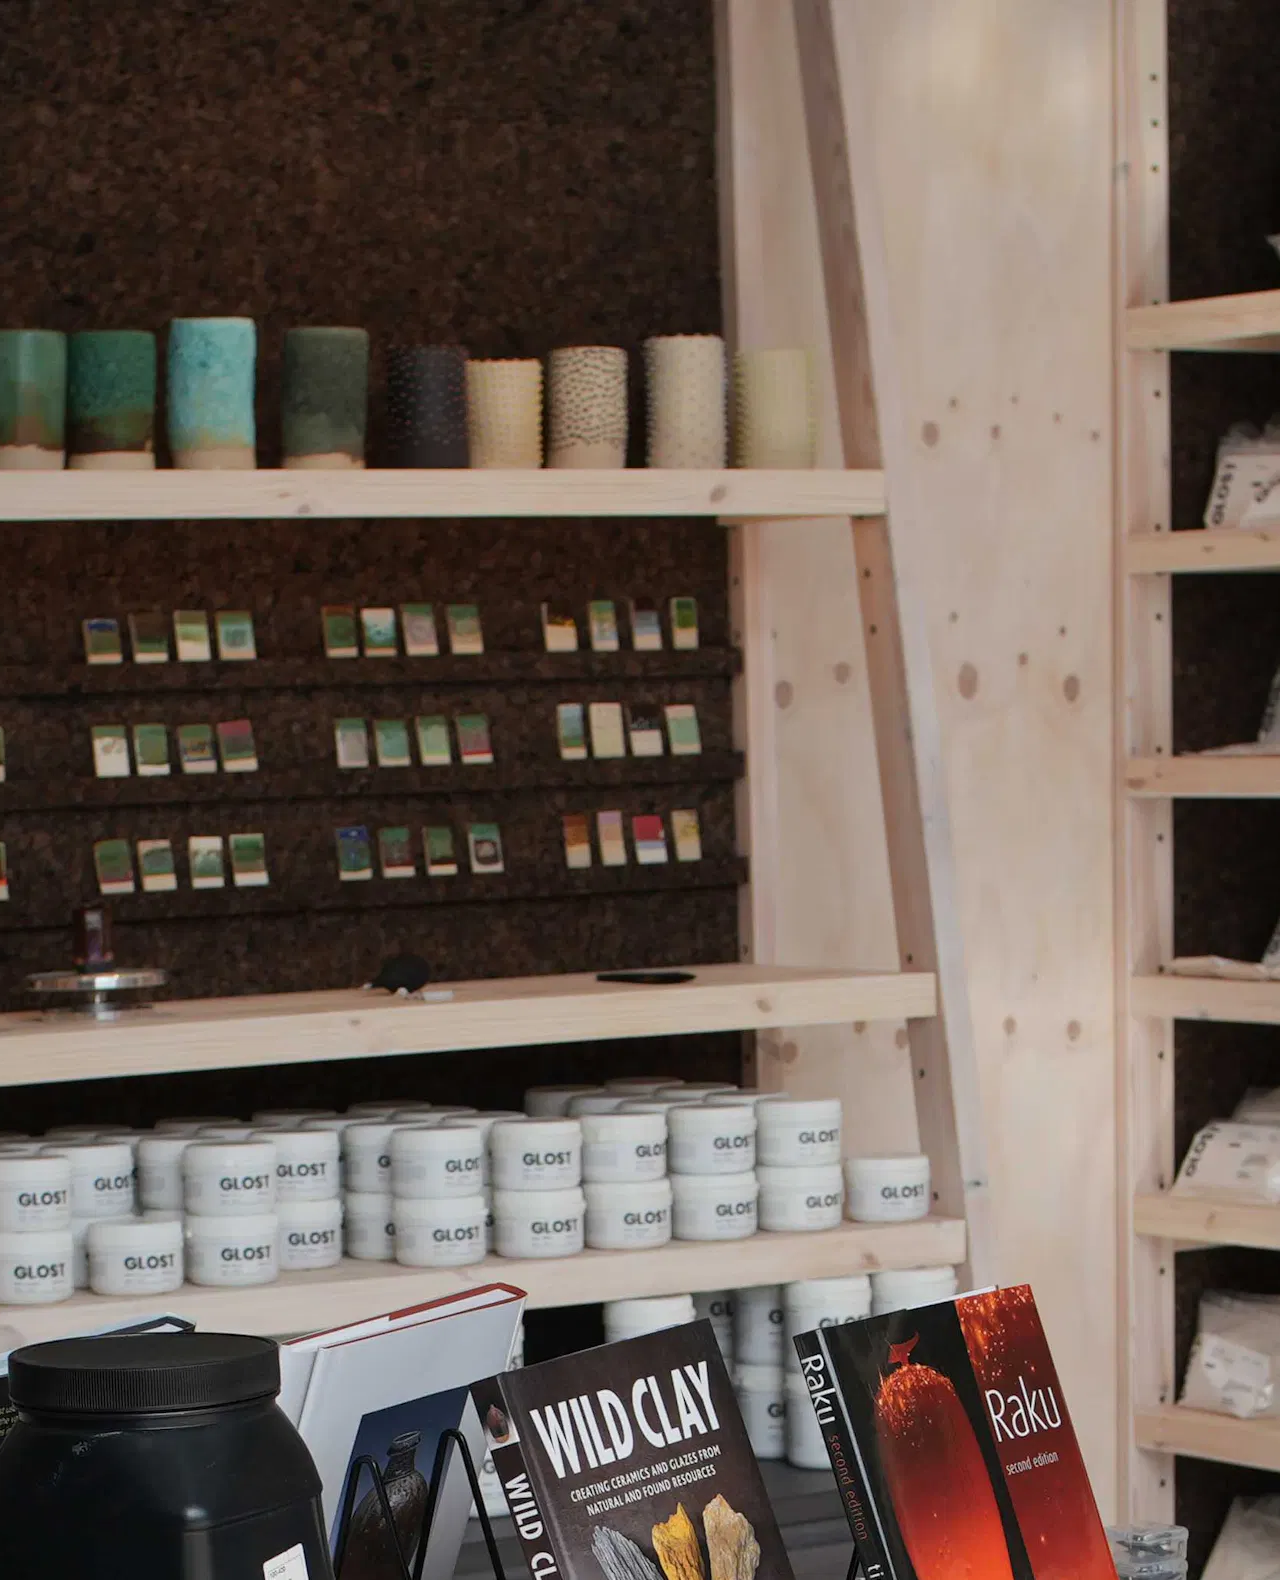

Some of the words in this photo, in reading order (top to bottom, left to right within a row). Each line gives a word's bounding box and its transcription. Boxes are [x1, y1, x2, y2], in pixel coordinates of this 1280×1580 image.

[1212, 462, 1237, 526] GLOST
[522, 1151, 572, 1167] GLOST
[276, 1162, 326, 1178] GLOST
[220, 1174, 270, 1191] GLOST
[18, 1190, 67, 1207] GLOST
[881, 1184, 925, 1200] GLOST
[433, 1226, 480, 1242] GLOST
[531, 1219, 578, 1234] GLOST
[288, 1229, 335, 1246] GLOST
[221, 1245, 271, 1262] GLOST
[124, 1254, 175, 1271] GLOST
[14, 1263, 65, 1280] GLOST
[984, 1375, 1062, 1442] Raku
[529, 1389, 634, 1479] WILD
[632, 1361, 720, 1448] CLAY
[801, 1354, 836, 1425] Raku
[828, 1434, 853, 1486] second
[844, 1489, 869, 1541] edition
[1005, 1456, 1032, 1476] second
[1032, 1451, 1059, 1468] edition
[570, 1480, 610, 1503] CREATING
[610, 1468, 651, 1490] CERAMICS
[651, 1461, 669, 1477] AND
[669, 1452, 698, 1471] GLAZES
[698, 1444, 721, 1461] FROM
[586, 1493, 624, 1517] NATURAL
[625, 1488, 643, 1504] AND
[643, 1479, 671, 1498] FOUND
[672, 1464, 716, 1488] RESOURCES
[505, 1472, 544, 1540] WILD
